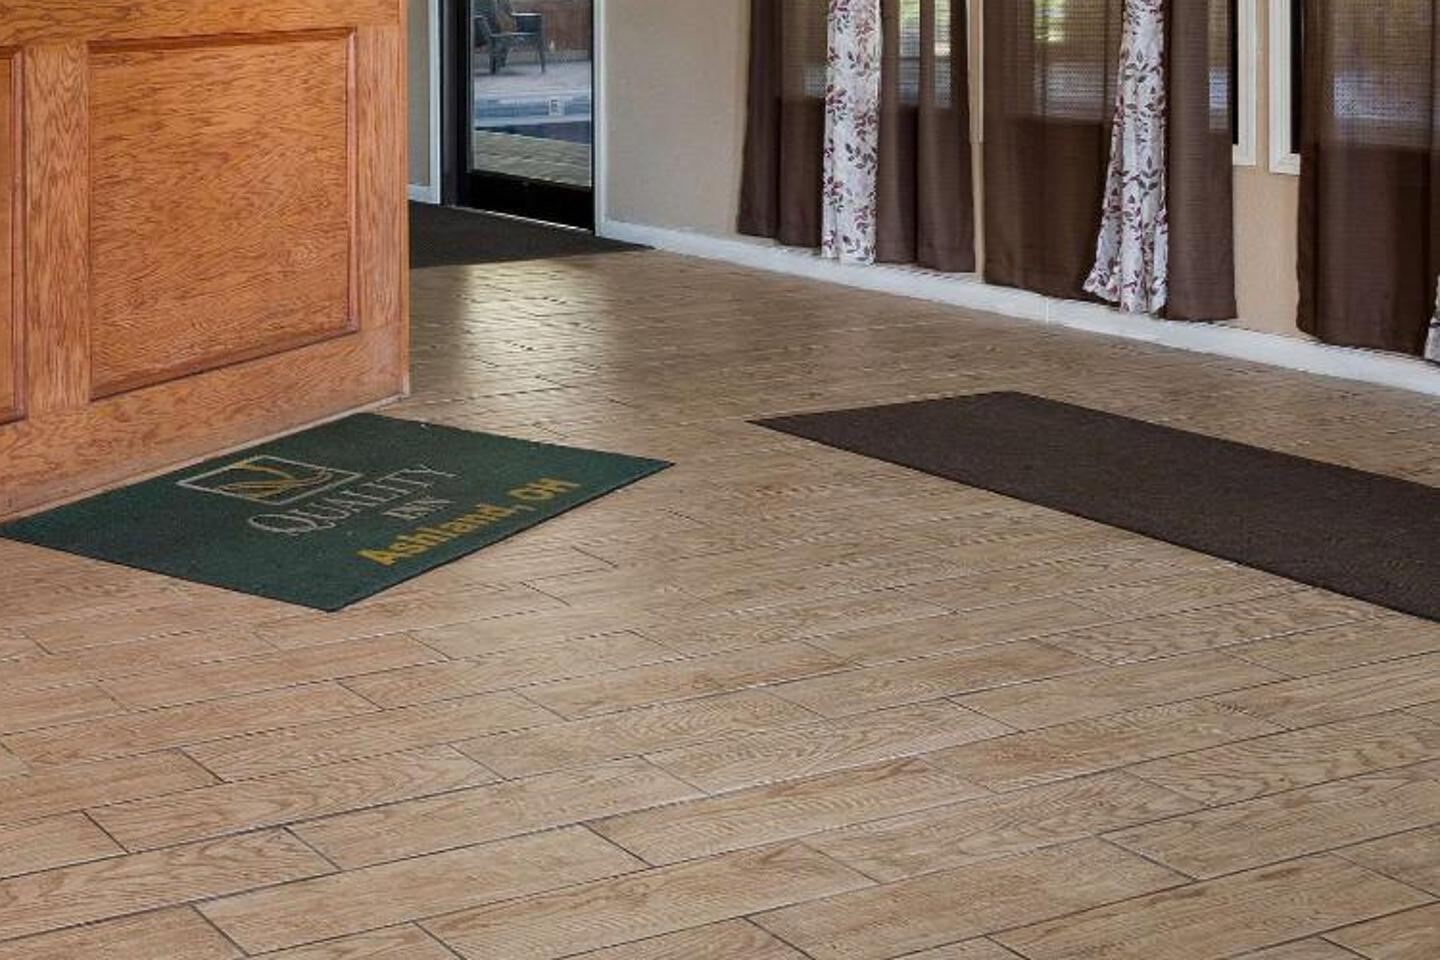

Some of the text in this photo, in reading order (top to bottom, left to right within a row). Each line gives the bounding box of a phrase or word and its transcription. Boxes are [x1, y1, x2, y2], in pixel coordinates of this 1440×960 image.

[248, 463, 458, 536] QUALITY
[509, 477, 581, 501] OH
[382, 498, 452, 521] INN
